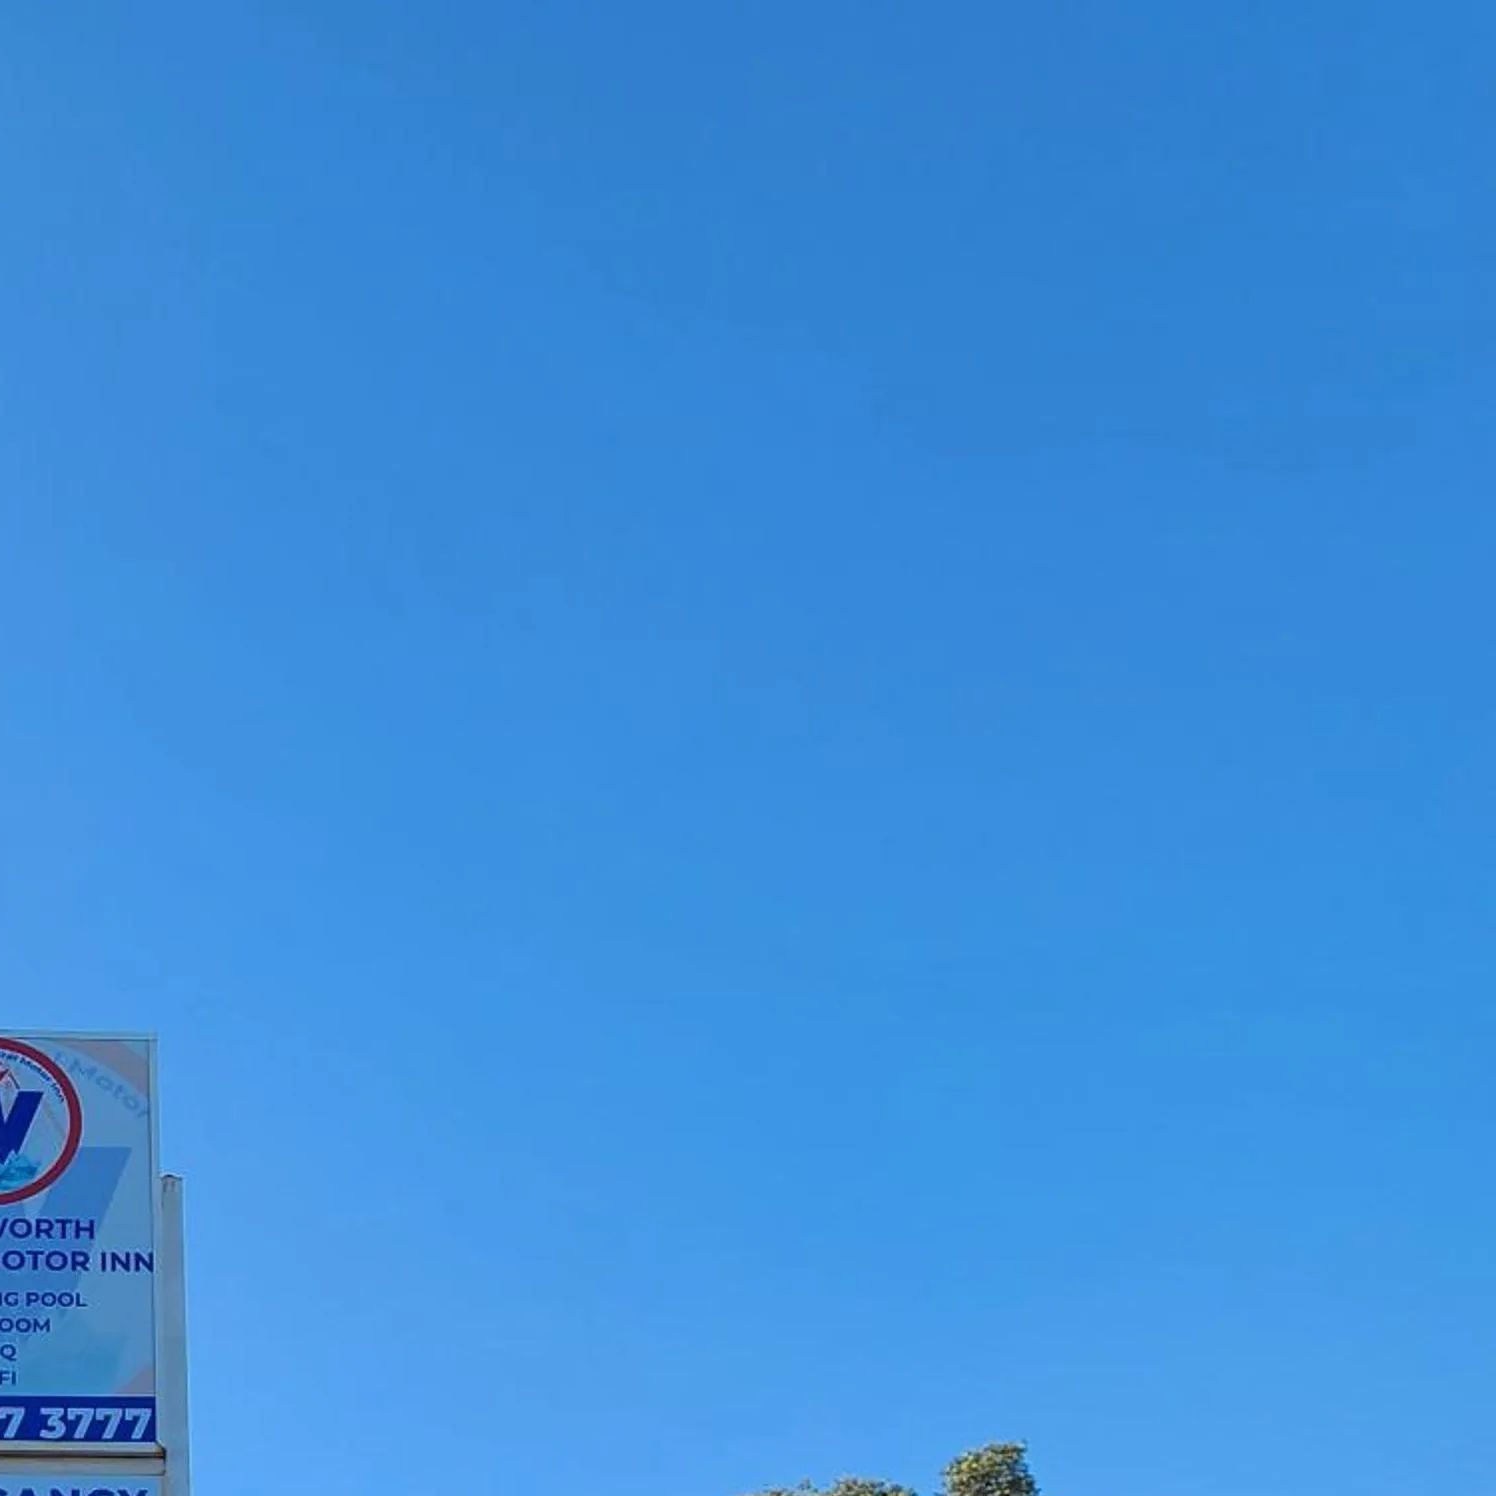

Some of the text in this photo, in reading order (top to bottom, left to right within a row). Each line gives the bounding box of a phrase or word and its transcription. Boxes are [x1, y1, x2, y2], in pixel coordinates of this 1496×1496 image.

[100, 1251, 155, 1273] INN
[25, 1292, 88, 1308] POOL
[39, 1407, 153, 1440] 3777
